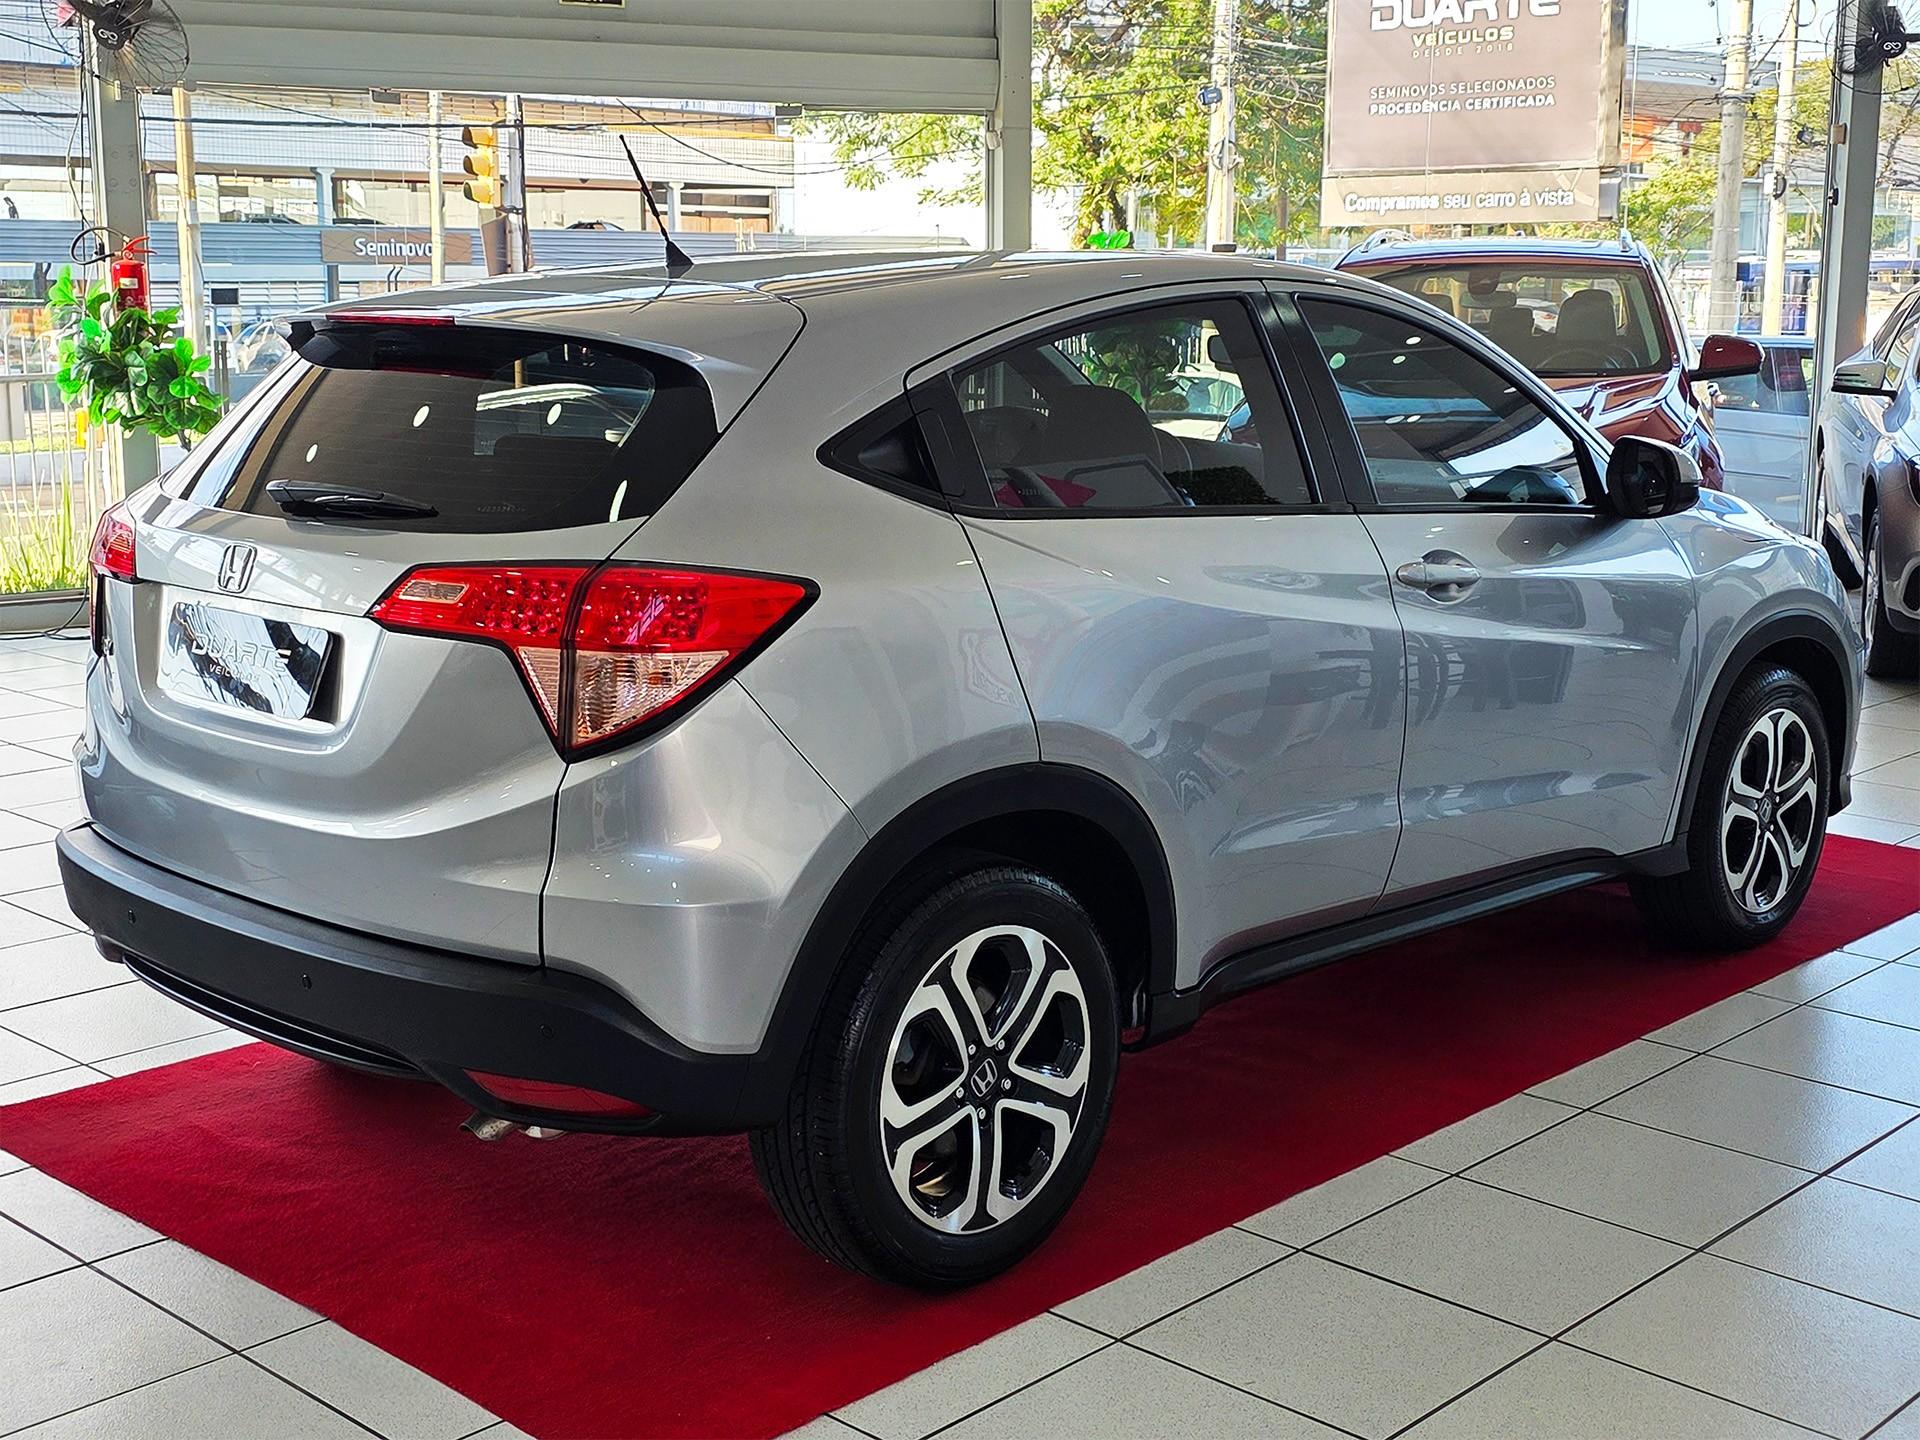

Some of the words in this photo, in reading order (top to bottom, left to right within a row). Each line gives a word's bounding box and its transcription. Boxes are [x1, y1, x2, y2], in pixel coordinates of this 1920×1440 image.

[1412, 26, 1514, 47] VEÍCULOS
[1412, 47, 1463, 58] DESDE
[1370, 84, 1446, 99] SEMINOVOS
[1450, 76, 1555, 95] SELECIONADOS
[1369, 99, 1461, 115] PROCEDÊNCIA
[1465, 94, 1555, 111] CERTIFICADA
[1344, 193, 1440, 216] Compramos
[1443, 194, 1471, 209] seu
[1475, 192, 1515, 208] carro
[1519, 188, 1531, 207] à
[1534, 188, 1574, 206] vista
[192, 632, 292, 673] DUARTE
[209, 663, 259, 682] VEICO
